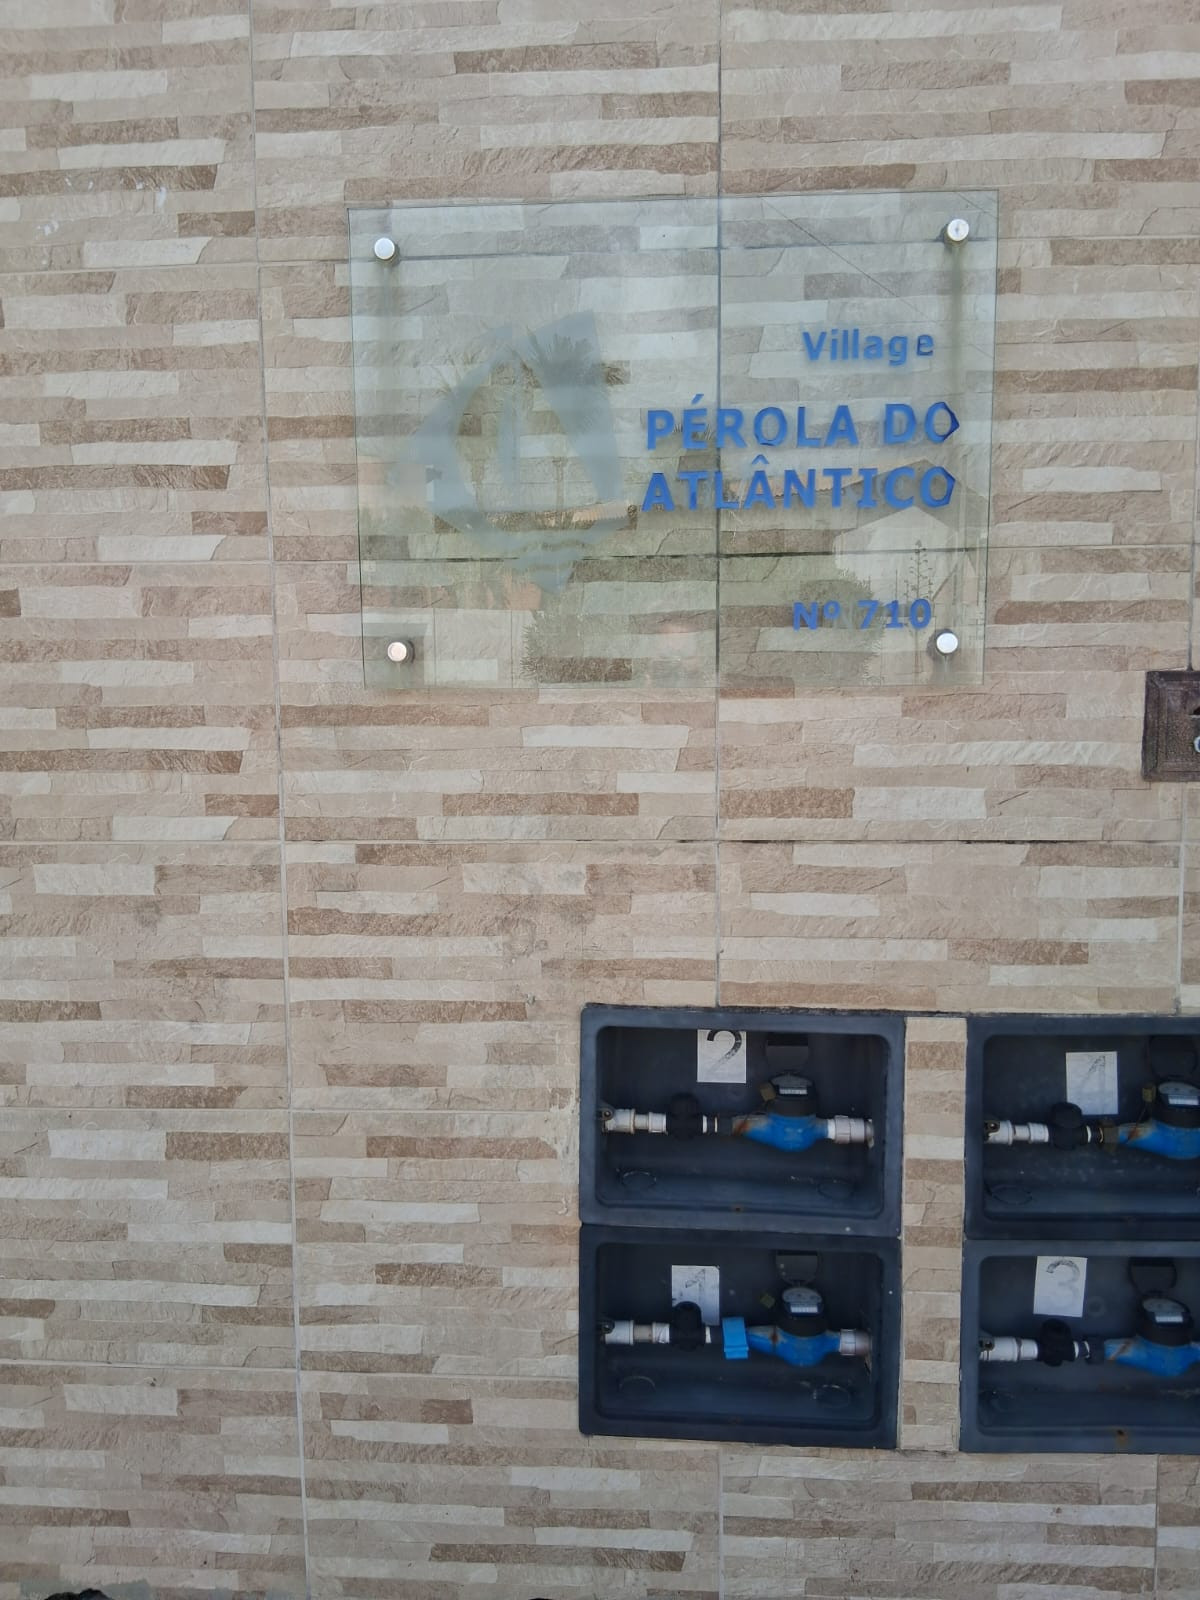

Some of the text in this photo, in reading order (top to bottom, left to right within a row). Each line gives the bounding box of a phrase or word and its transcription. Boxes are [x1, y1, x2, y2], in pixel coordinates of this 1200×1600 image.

[802, 329, 934, 366] Village
[646, 393, 960, 450] PÉROLA DO
[641, 454, 956, 512] ATLÂNTICO
[856, 598, 932, 630] 710
